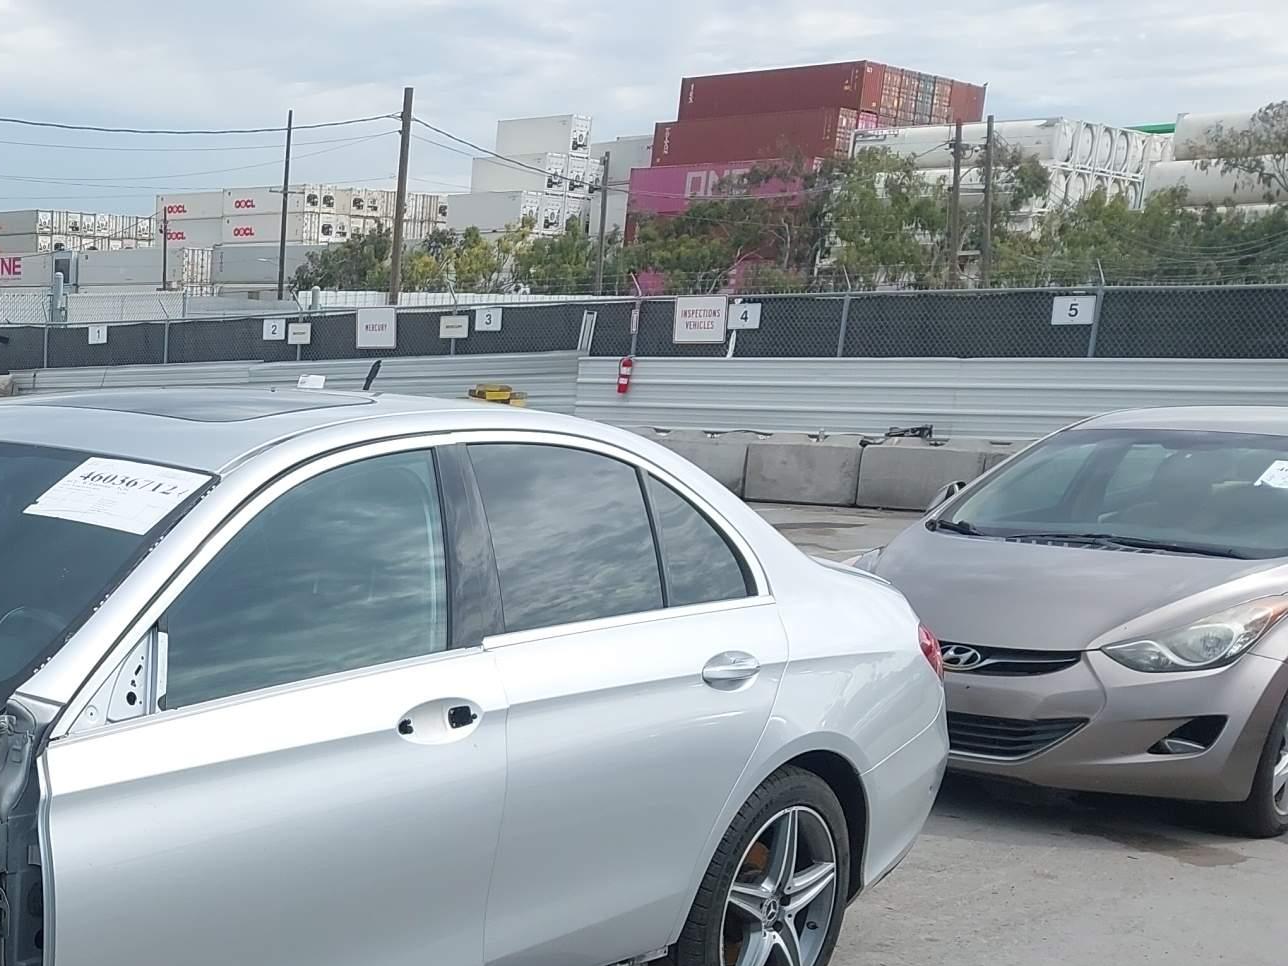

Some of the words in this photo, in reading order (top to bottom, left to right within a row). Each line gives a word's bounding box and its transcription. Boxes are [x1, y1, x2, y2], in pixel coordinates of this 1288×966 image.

[235, 199, 255, 208] OOCL
[167, 205, 187, 213] OOCL
[166, 231, 186, 240] OOCL
[233, 227, 255, 236] OOCL
[680, 309, 721, 319] INSPECTIONS
[1068, 303, 1079, 317] 5
[485, 313, 492, 326] 3
[740, 309, 749, 323] 4
[271, 324, 278, 335] 2
[365, 323, 388, 332] MERCURY
[685, 320, 715, 330] VEHICLES
